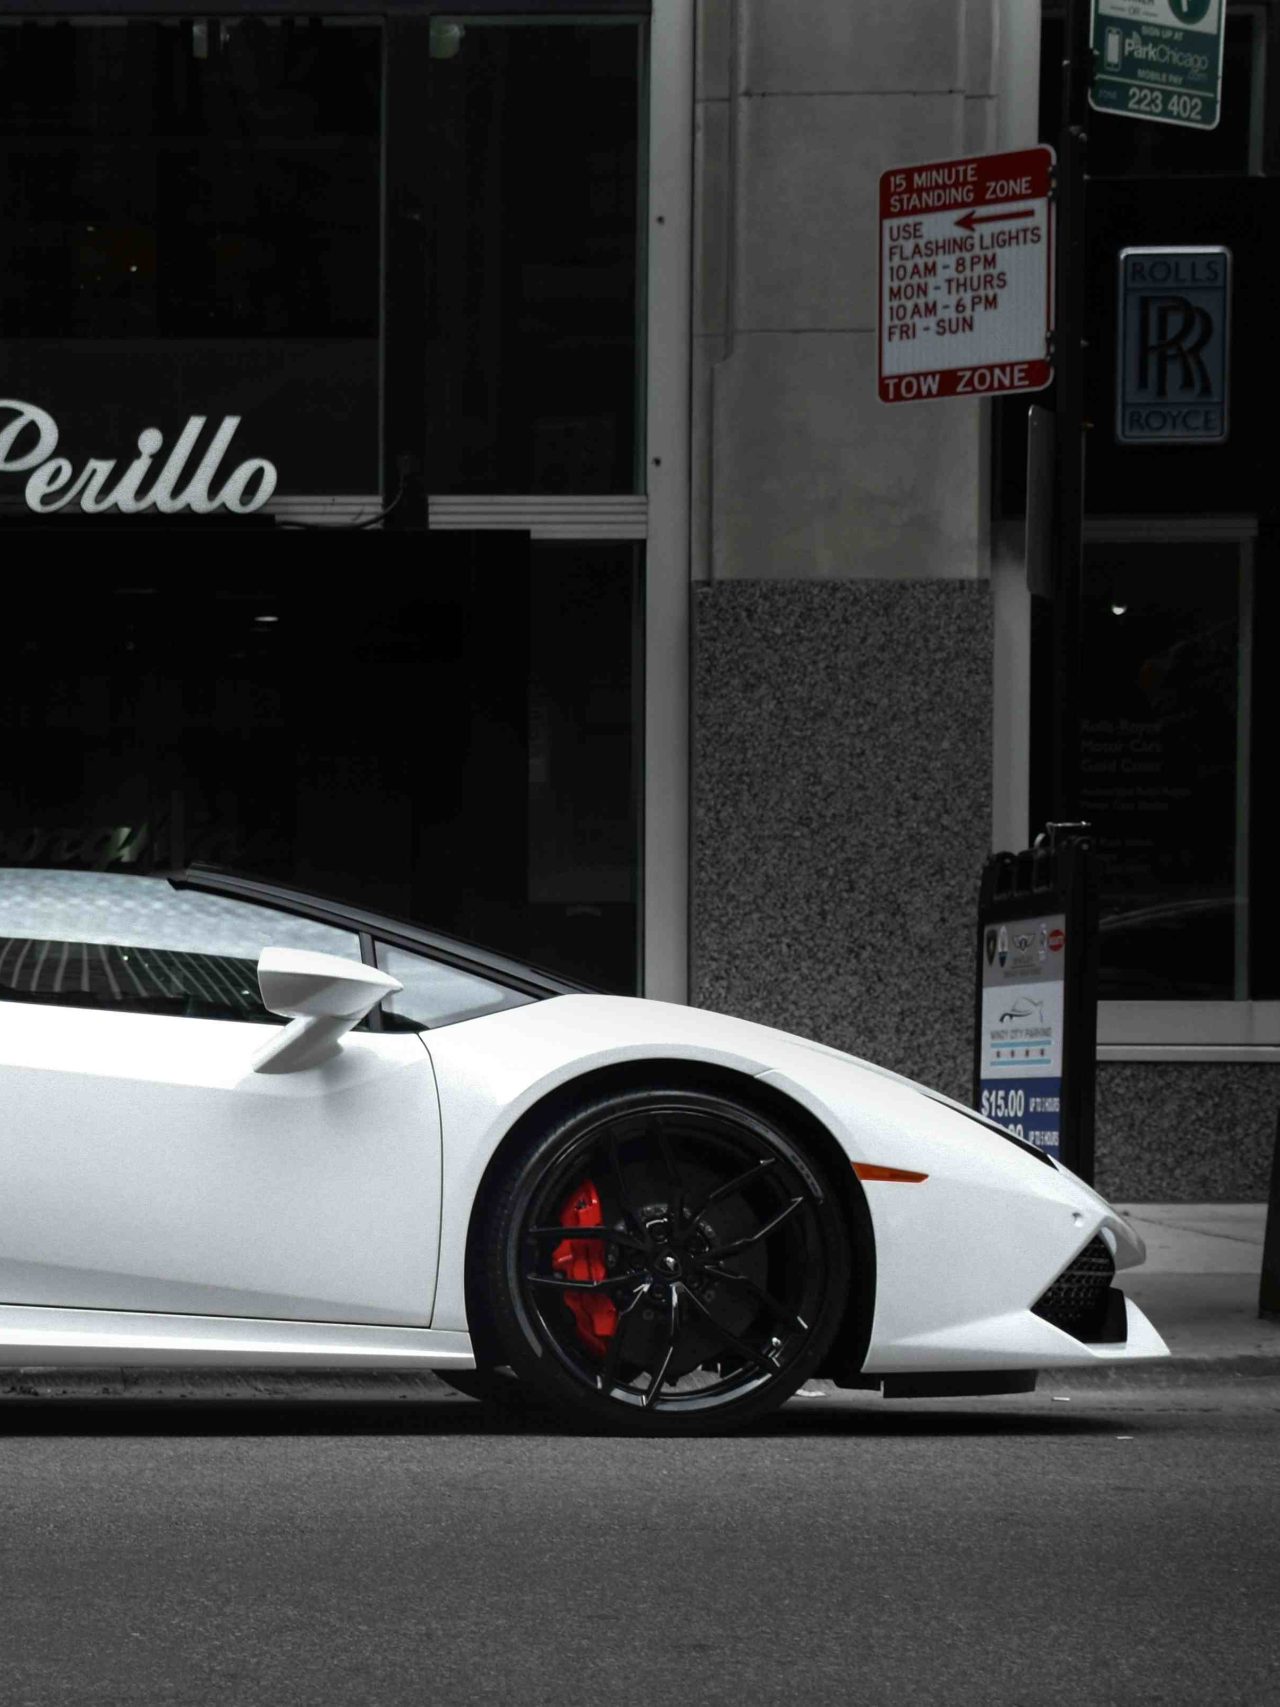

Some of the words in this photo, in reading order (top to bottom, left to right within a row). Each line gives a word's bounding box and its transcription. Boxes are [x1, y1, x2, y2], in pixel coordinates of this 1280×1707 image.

[1124, 37, 1209, 73] ParkChicago
[1128, 86, 1163, 114] 223
[1167, 93, 1203, 120] 402
[889, 174, 907, 193] 15
[912, 163, 979, 190] MINUTE
[888, 186, 975, 213] STANDING
[984, 176, 1033, 201] ZONE
[888, 236, 975, 262] FLASHING
[979, 226, 1042, 250] LIGHTS
[889, 222, 924, 242] USE
[1131, 260, 1219, 283] ROLLS
[888, 282, 929, 303] MON
[945, 272, 1008, 295] THURS
[888, 323, 917, 342] FRI
[935, 316, 975, 336] SUN
[883, 373, 941, 400] TOW
[955, 363, 1031, 393] ZONE
[1128, 409, 1218, 432] ROYCE
[981, 1089, 1024, 1117] $15.00
